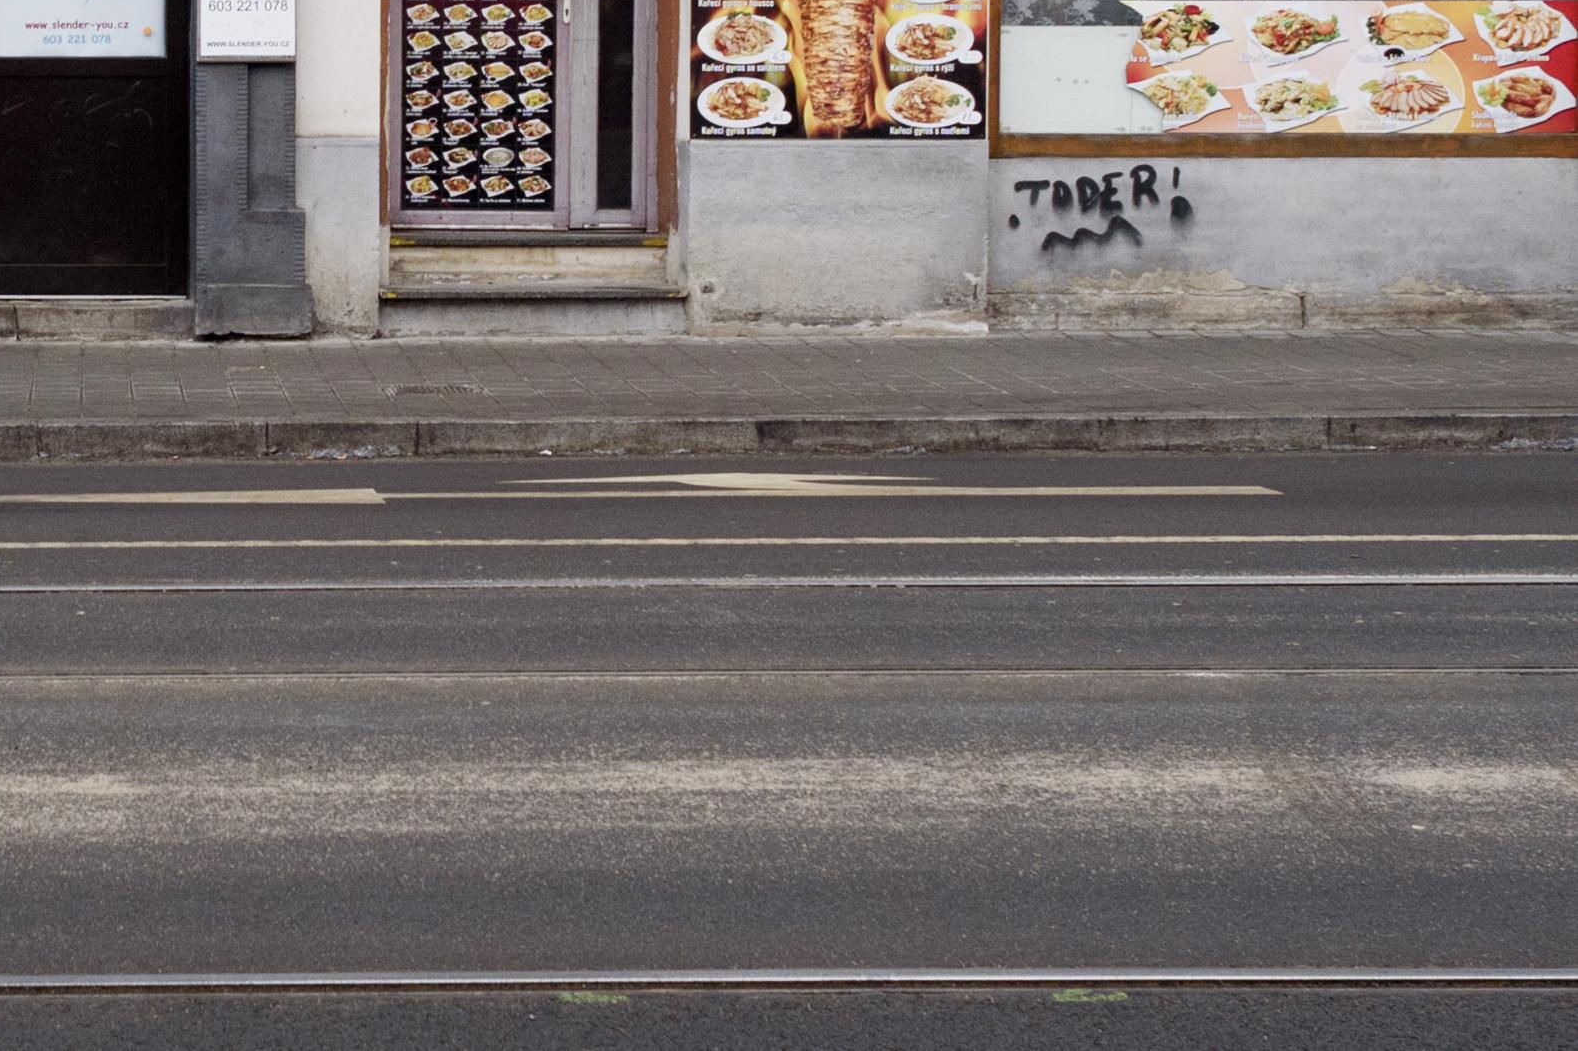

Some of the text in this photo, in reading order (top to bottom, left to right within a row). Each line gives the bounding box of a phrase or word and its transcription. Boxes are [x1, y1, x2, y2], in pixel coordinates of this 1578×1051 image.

[208, 0, 289, 12] 603 221 078
[24, 20, 130, 32] www.slender-you.cz
[42, 34, 112, 44] 603 221 078
